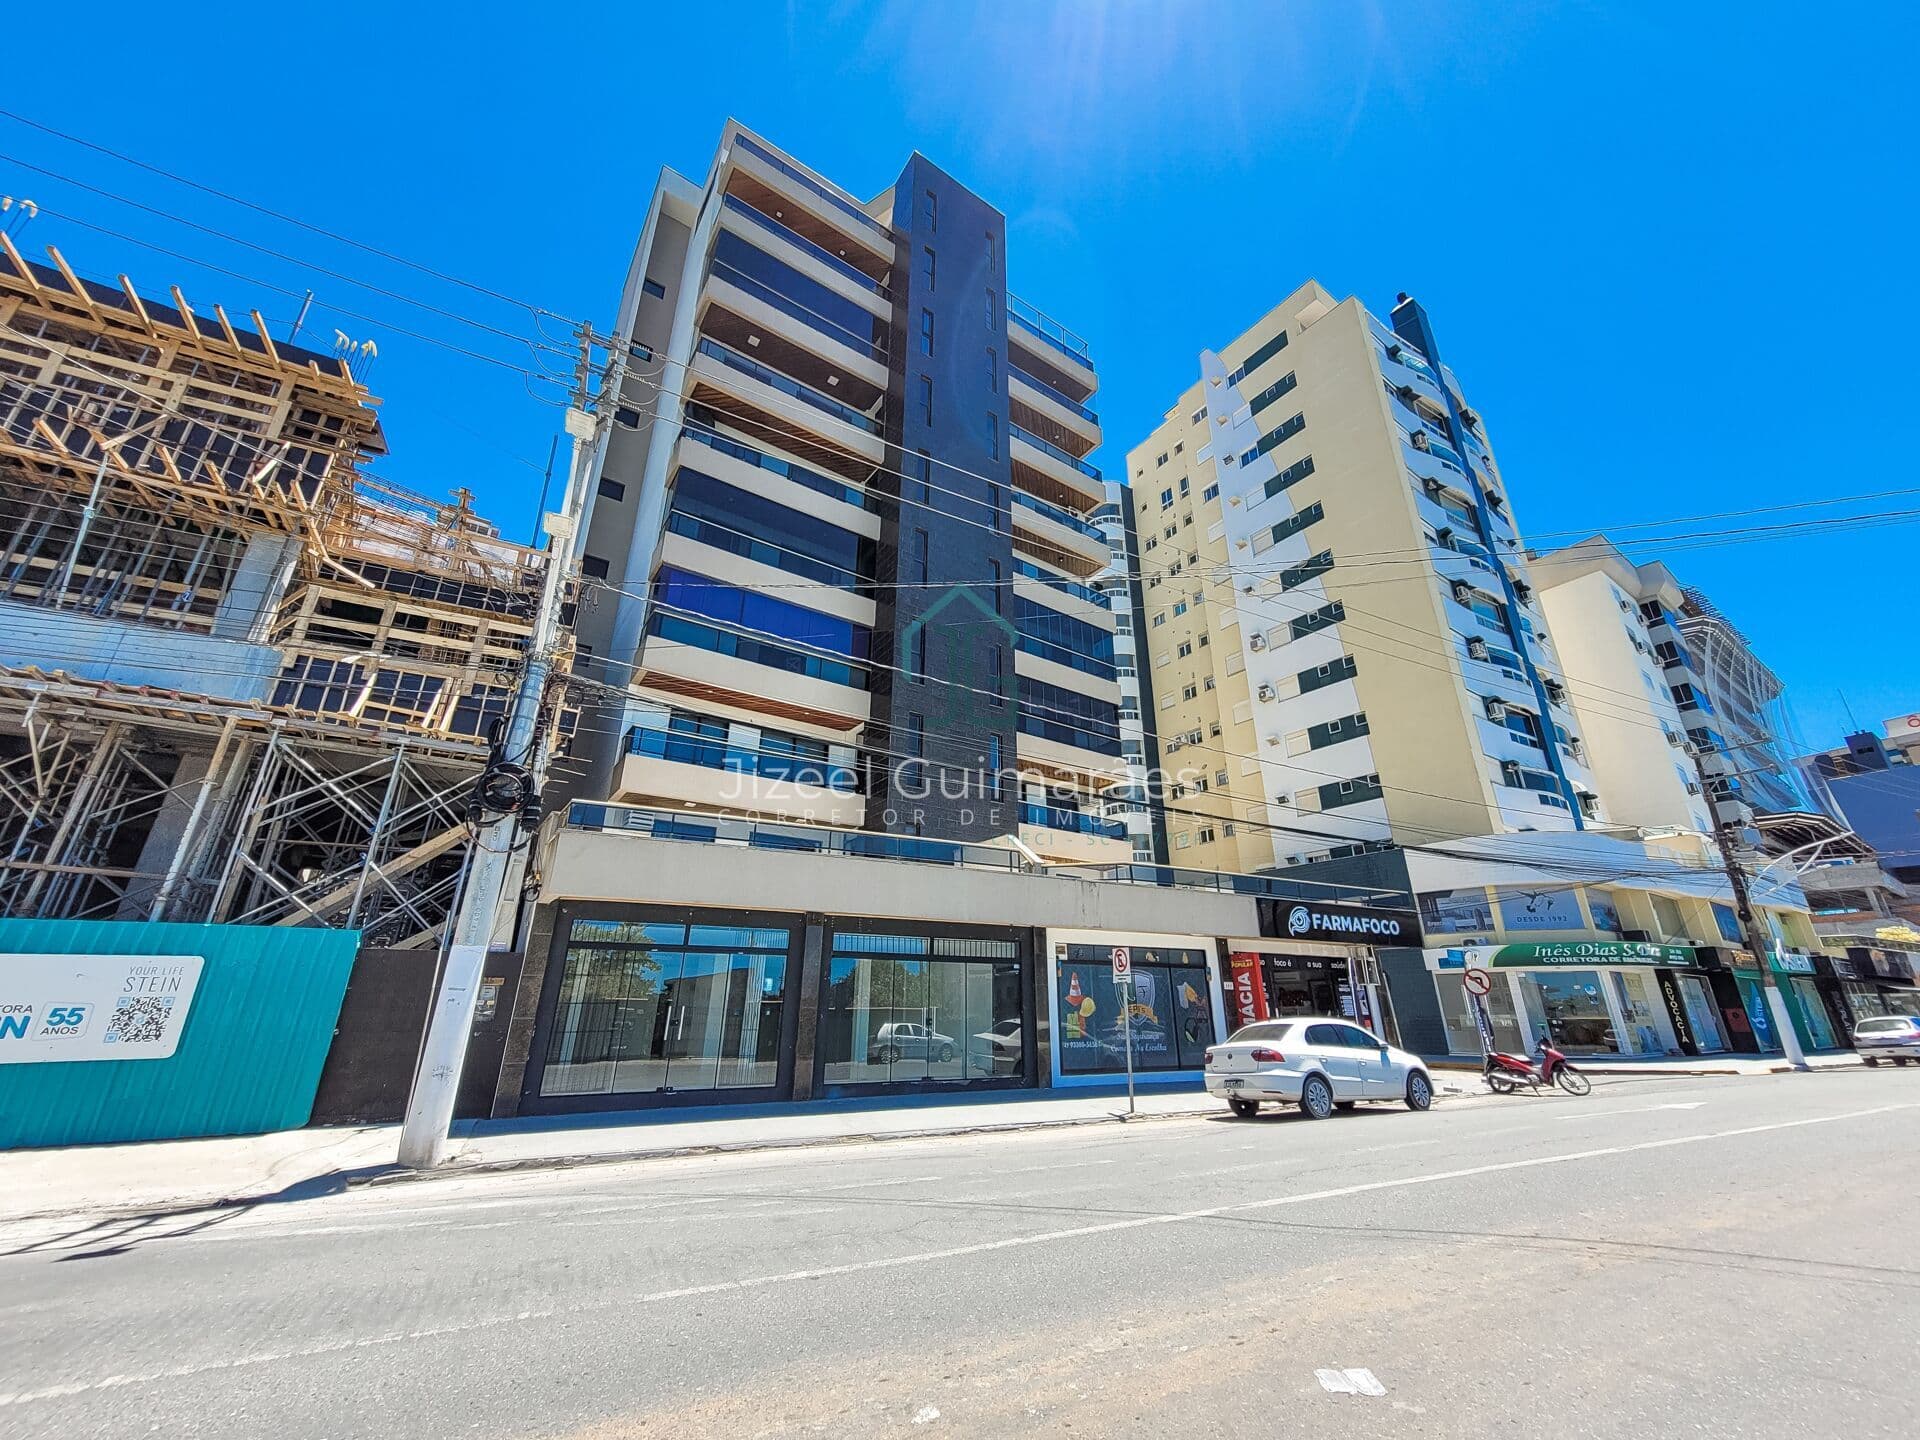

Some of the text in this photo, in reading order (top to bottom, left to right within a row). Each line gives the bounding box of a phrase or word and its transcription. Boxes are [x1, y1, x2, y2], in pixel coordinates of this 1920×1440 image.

[1311, 913, 1400, 936] FARMAFOCO
[1534, 944, 1571, 957] Inês
[1576, 943, 1618, 956] Dias
[129, 966, 185, 976] YOUR LIFE
[123, 976, 182, 993] STEIN
[46, 1006, 86, 1026] 55
[1664, 980, 1690, 1044] ADVOCACIA
[0, 1015, 31, 1039] N
[40, 1026, 79, 1036] ANOS
